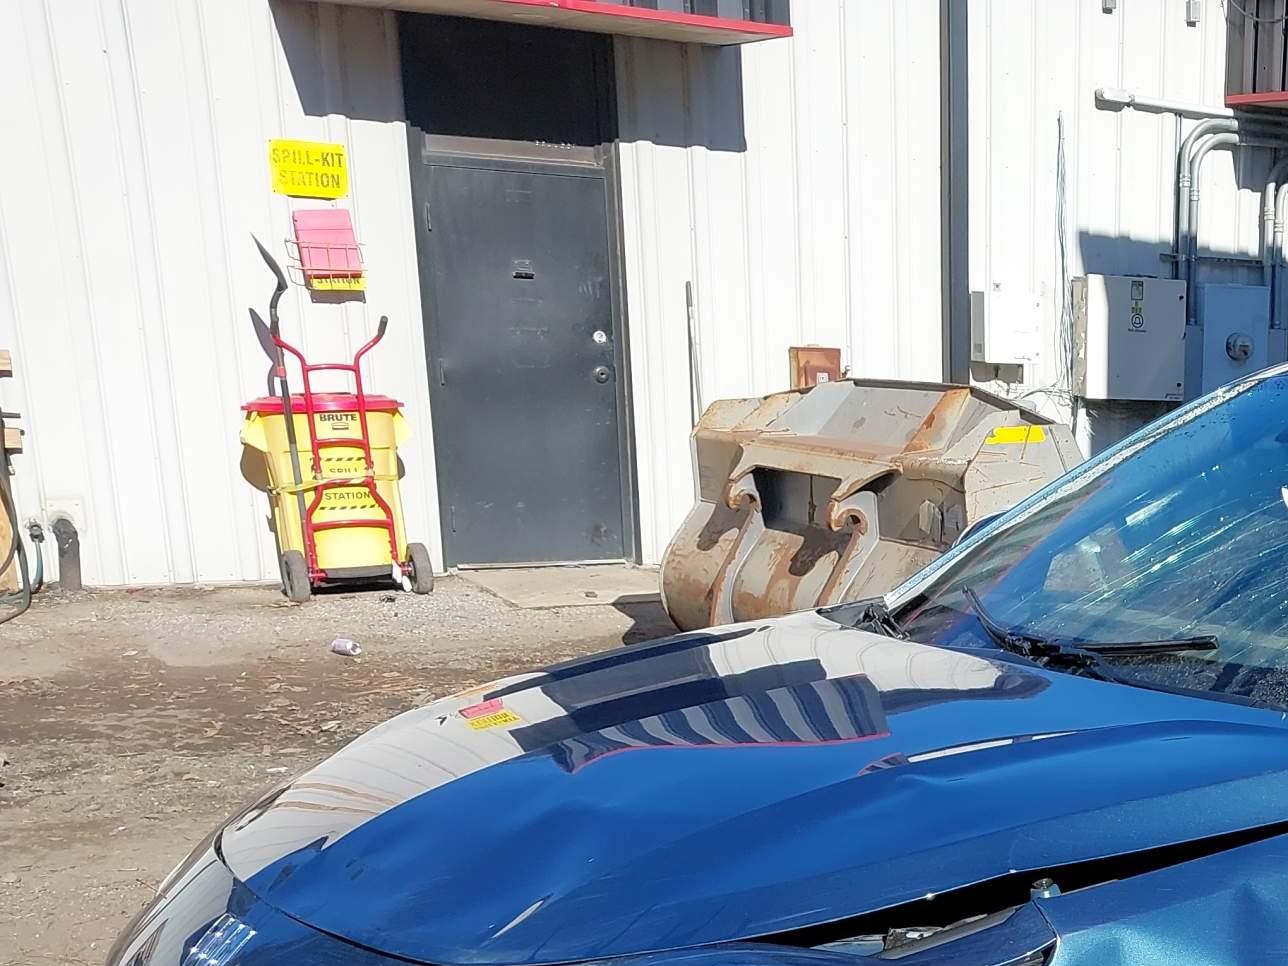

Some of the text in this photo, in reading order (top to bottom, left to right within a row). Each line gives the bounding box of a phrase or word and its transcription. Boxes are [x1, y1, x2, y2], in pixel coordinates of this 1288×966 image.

[272, 147, 344, 168] SPILL-KIT
[280, 169, 341, 189] STATION
[319, 414, 358, 422] BRUTE
[324, 491, 371, 501] STATION
